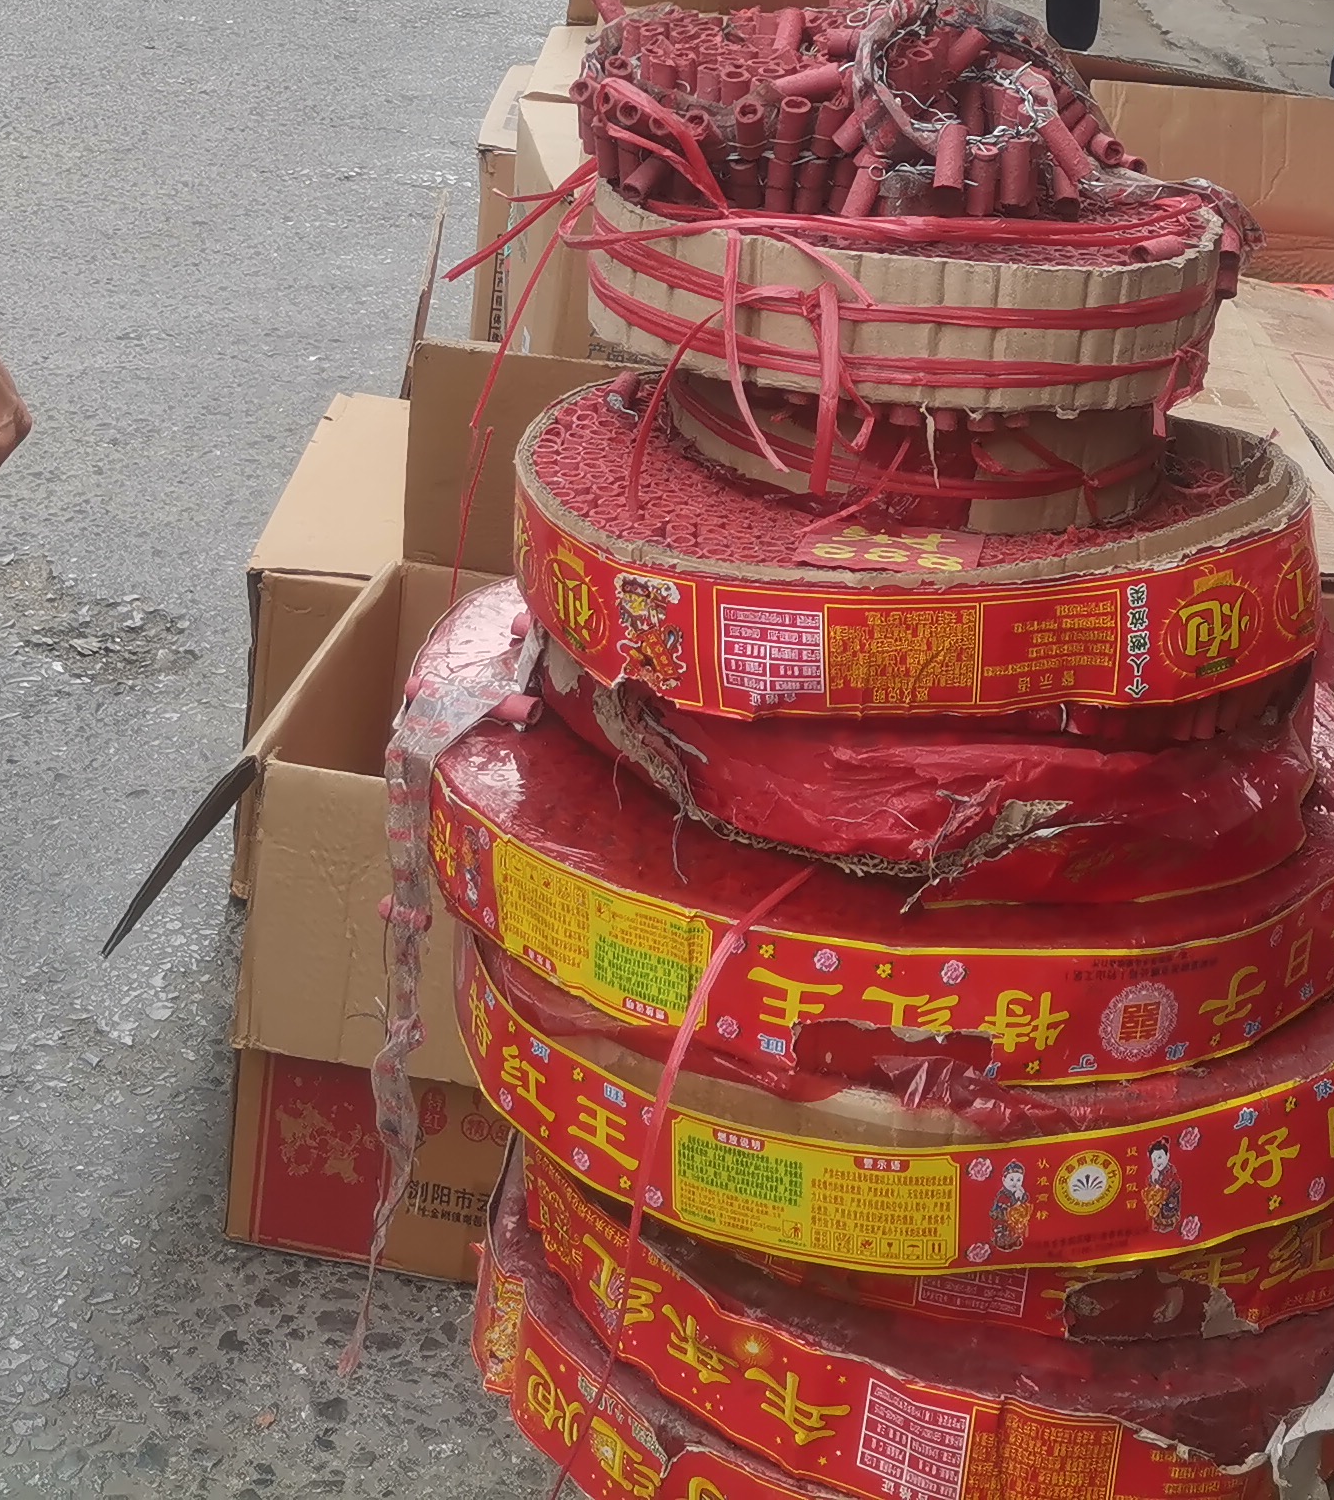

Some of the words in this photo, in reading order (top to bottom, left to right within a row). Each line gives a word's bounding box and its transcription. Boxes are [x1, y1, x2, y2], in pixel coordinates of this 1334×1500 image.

[1125, 583, 1150, 698] 个人燃放类
[1179, 593, 1250, 657] 炮
[1018, 670, 1076, 693] 警示语
[716, 1131, 762, 1150] 燃放说明
[862, 1157, 903, 1171] 警示语
[581, 1233, 852, 1446] 年年红
